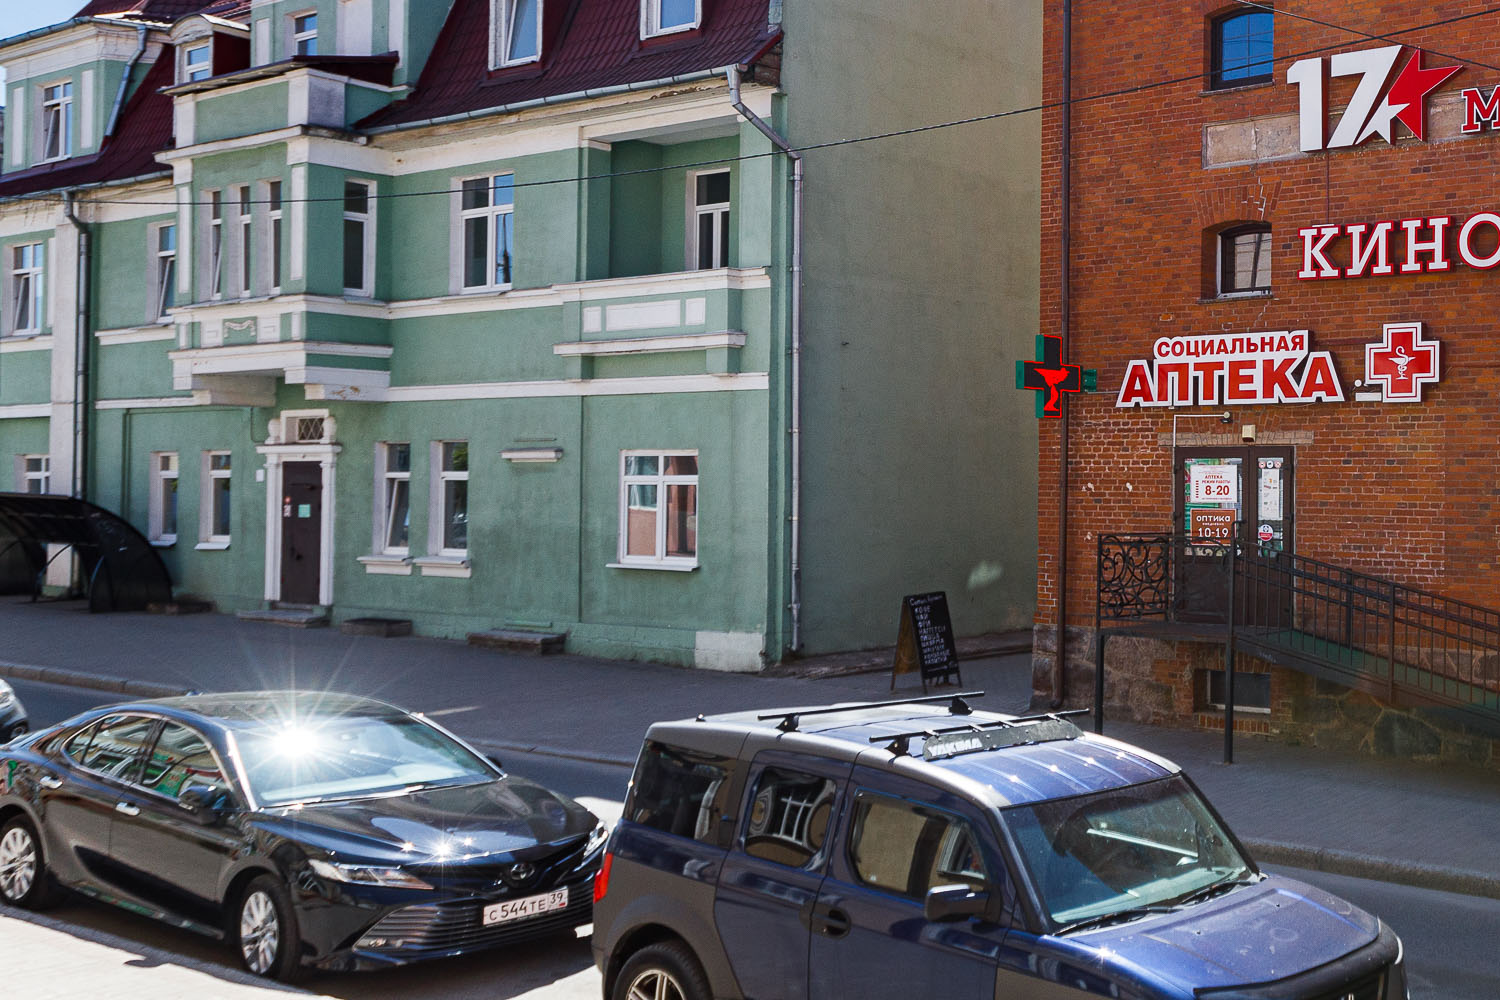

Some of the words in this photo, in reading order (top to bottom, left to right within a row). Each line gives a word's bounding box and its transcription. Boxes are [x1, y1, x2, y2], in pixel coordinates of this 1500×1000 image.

[1156, 334, 1305, 358] СОЦИАЛЬНАЯ
[1118, 354, 1342, 405] АПТЕКА
[1205, 485, 1230, 496] 8-20
[1198, 527, 1229, 538] 10-19
